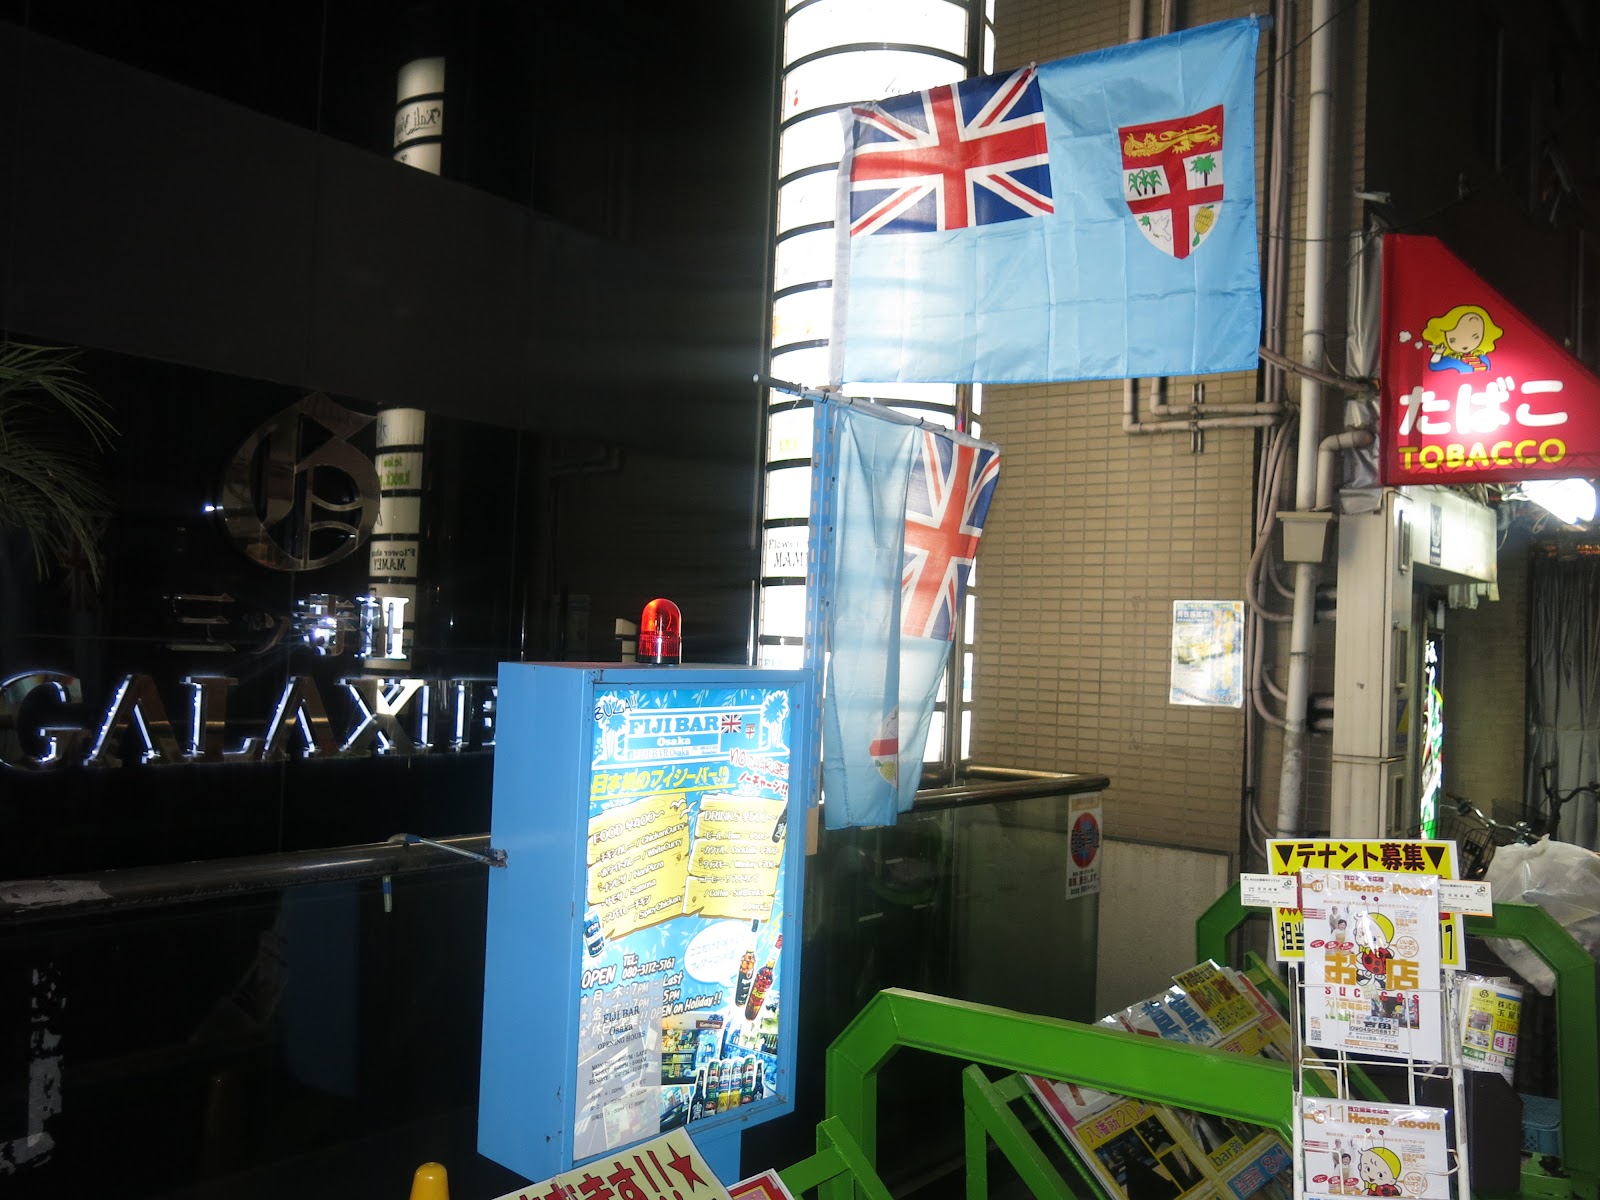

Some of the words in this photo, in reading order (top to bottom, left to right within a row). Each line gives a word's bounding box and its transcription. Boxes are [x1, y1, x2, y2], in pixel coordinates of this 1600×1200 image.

[1398, 376, 1568, 436] たばこ
[1398, 438, 1566, 471] TOBACCO
[629, 717, 672, 734] FIJI
[675, 716, 719, 733] BAR
[657, 736, 692, 747] Osaka
[704, 810, 740, 822] DRINKS
[593, 824, 624, 845] FOOD
[1297, 843, 1425, 871] テナント募集
[1344, 881, 1384, 893] Home
[1392, 883, 1433, 896] Room
[623, 953, 639, 967] TEL:
[582, 964, 616, 989] OPEN
[663, 970, 683, 987] Last
[673, 1001, 684, 1015] on
[684, 991, 723, 1012] Holiday!!
[622, 1005, 640, 1019] BAR
[609, 1022, 634, 1036] Osaka
[597, 1035, 625, 1050] OPENING
[626, 1030, 646, 1043] HOURS
[1348, 1112, 1389, 1126] Home
